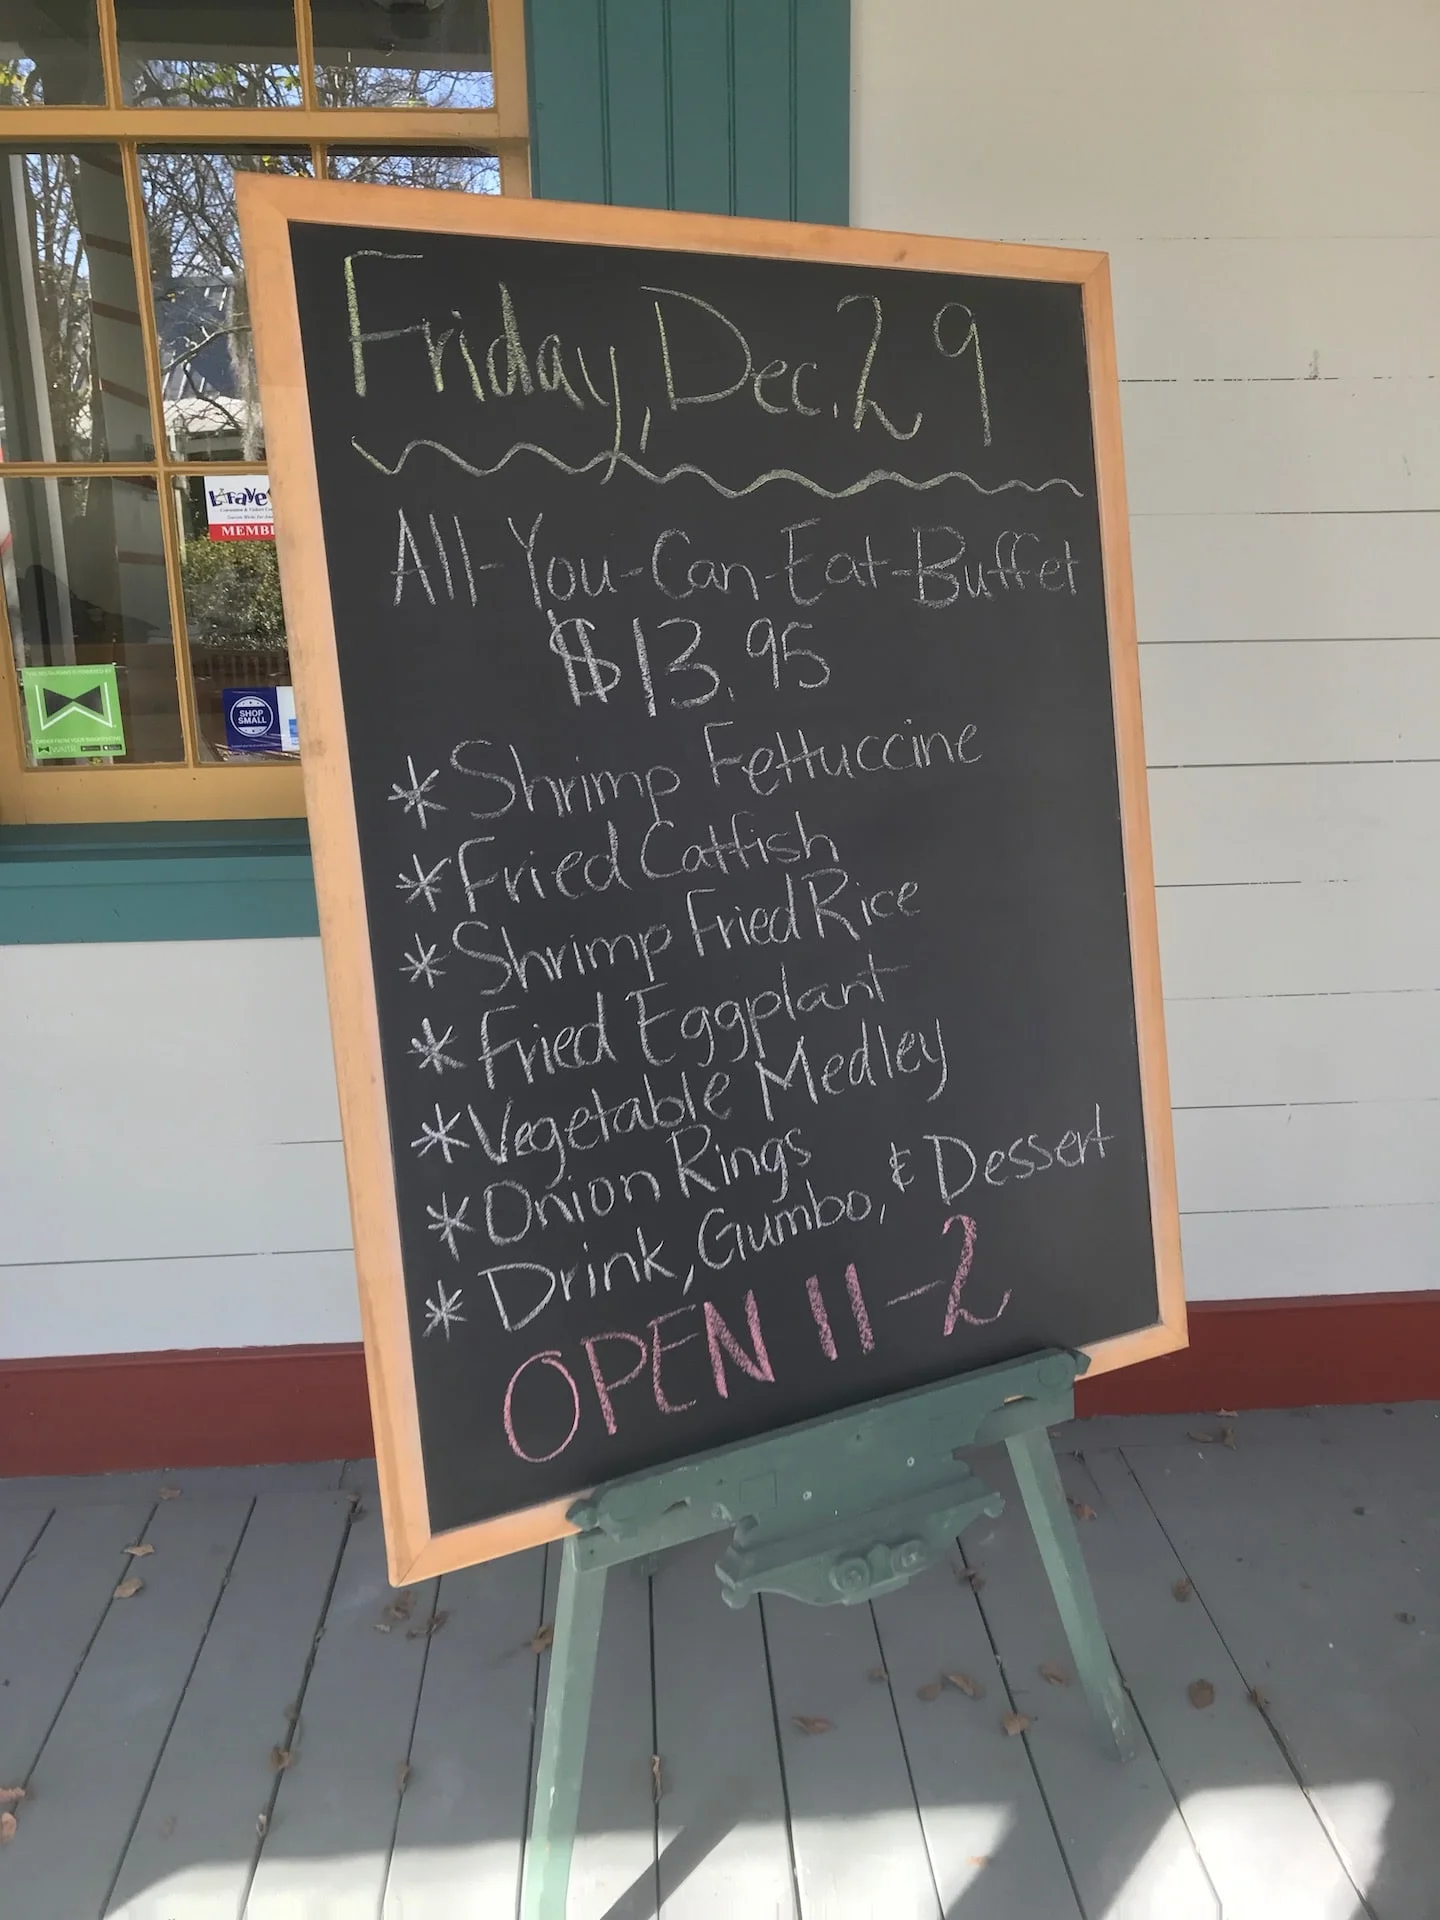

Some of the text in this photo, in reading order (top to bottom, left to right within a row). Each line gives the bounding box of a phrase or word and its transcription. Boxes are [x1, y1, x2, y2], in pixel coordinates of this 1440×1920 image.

[344, 249, 651, 484] Friday,
[640, 285, 840, 420] Dec.
[237, 716, 268, 725] SMALL
[239, 709, 264, 717] SHOP
[547, 608, 832, 717] $13.95
[449, 718, 984, 822] Shrimp Fettuccine
[456, 810, 840, 912] Fried Catfish
[452, 868, 921, 996] Shrimp Fried Rice
[478, 953, 911, 1090] Fried Eggplant
[467, 1017, 949, 1190] Vegetable Medley
[477, 1226, 695, 1332] Drink,
[697, 1179, 888, 1270] Gumbo,
[922, 1102, 1118, 1206] Dessert
[484, 1121, 812, 1246] Onion Rings
[503, 1288, 776, 1464] OPEN
